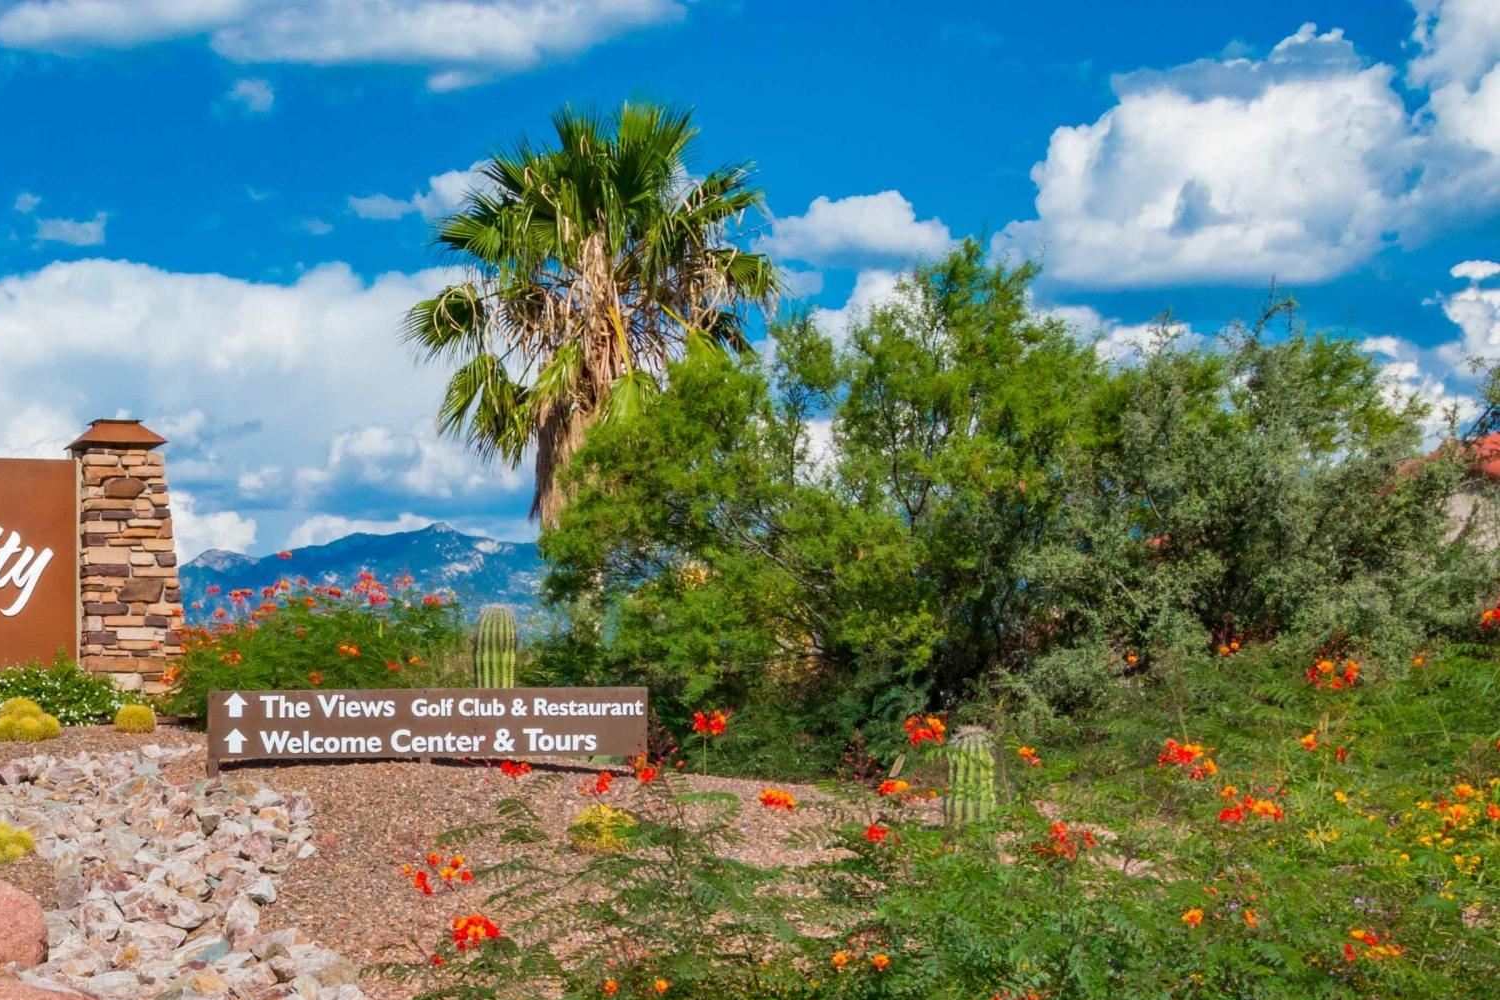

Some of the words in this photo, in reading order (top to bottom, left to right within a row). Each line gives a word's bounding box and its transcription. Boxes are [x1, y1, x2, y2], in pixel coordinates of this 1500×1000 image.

[260, 695, 311, 718] The
[317, 694, 396, 718] Views
[411, 698, 454, 717] Golf
[458, 698, 505, 717] Club
[511, 700, 527, 717] &
[533, 699, 644, 717] Restaurant
[260, 730, 382, 754] Welcome
[390, 728, 486, 753] Center
[493, 728, 515, 753] &
[523, 728, 597, 752] Tours
